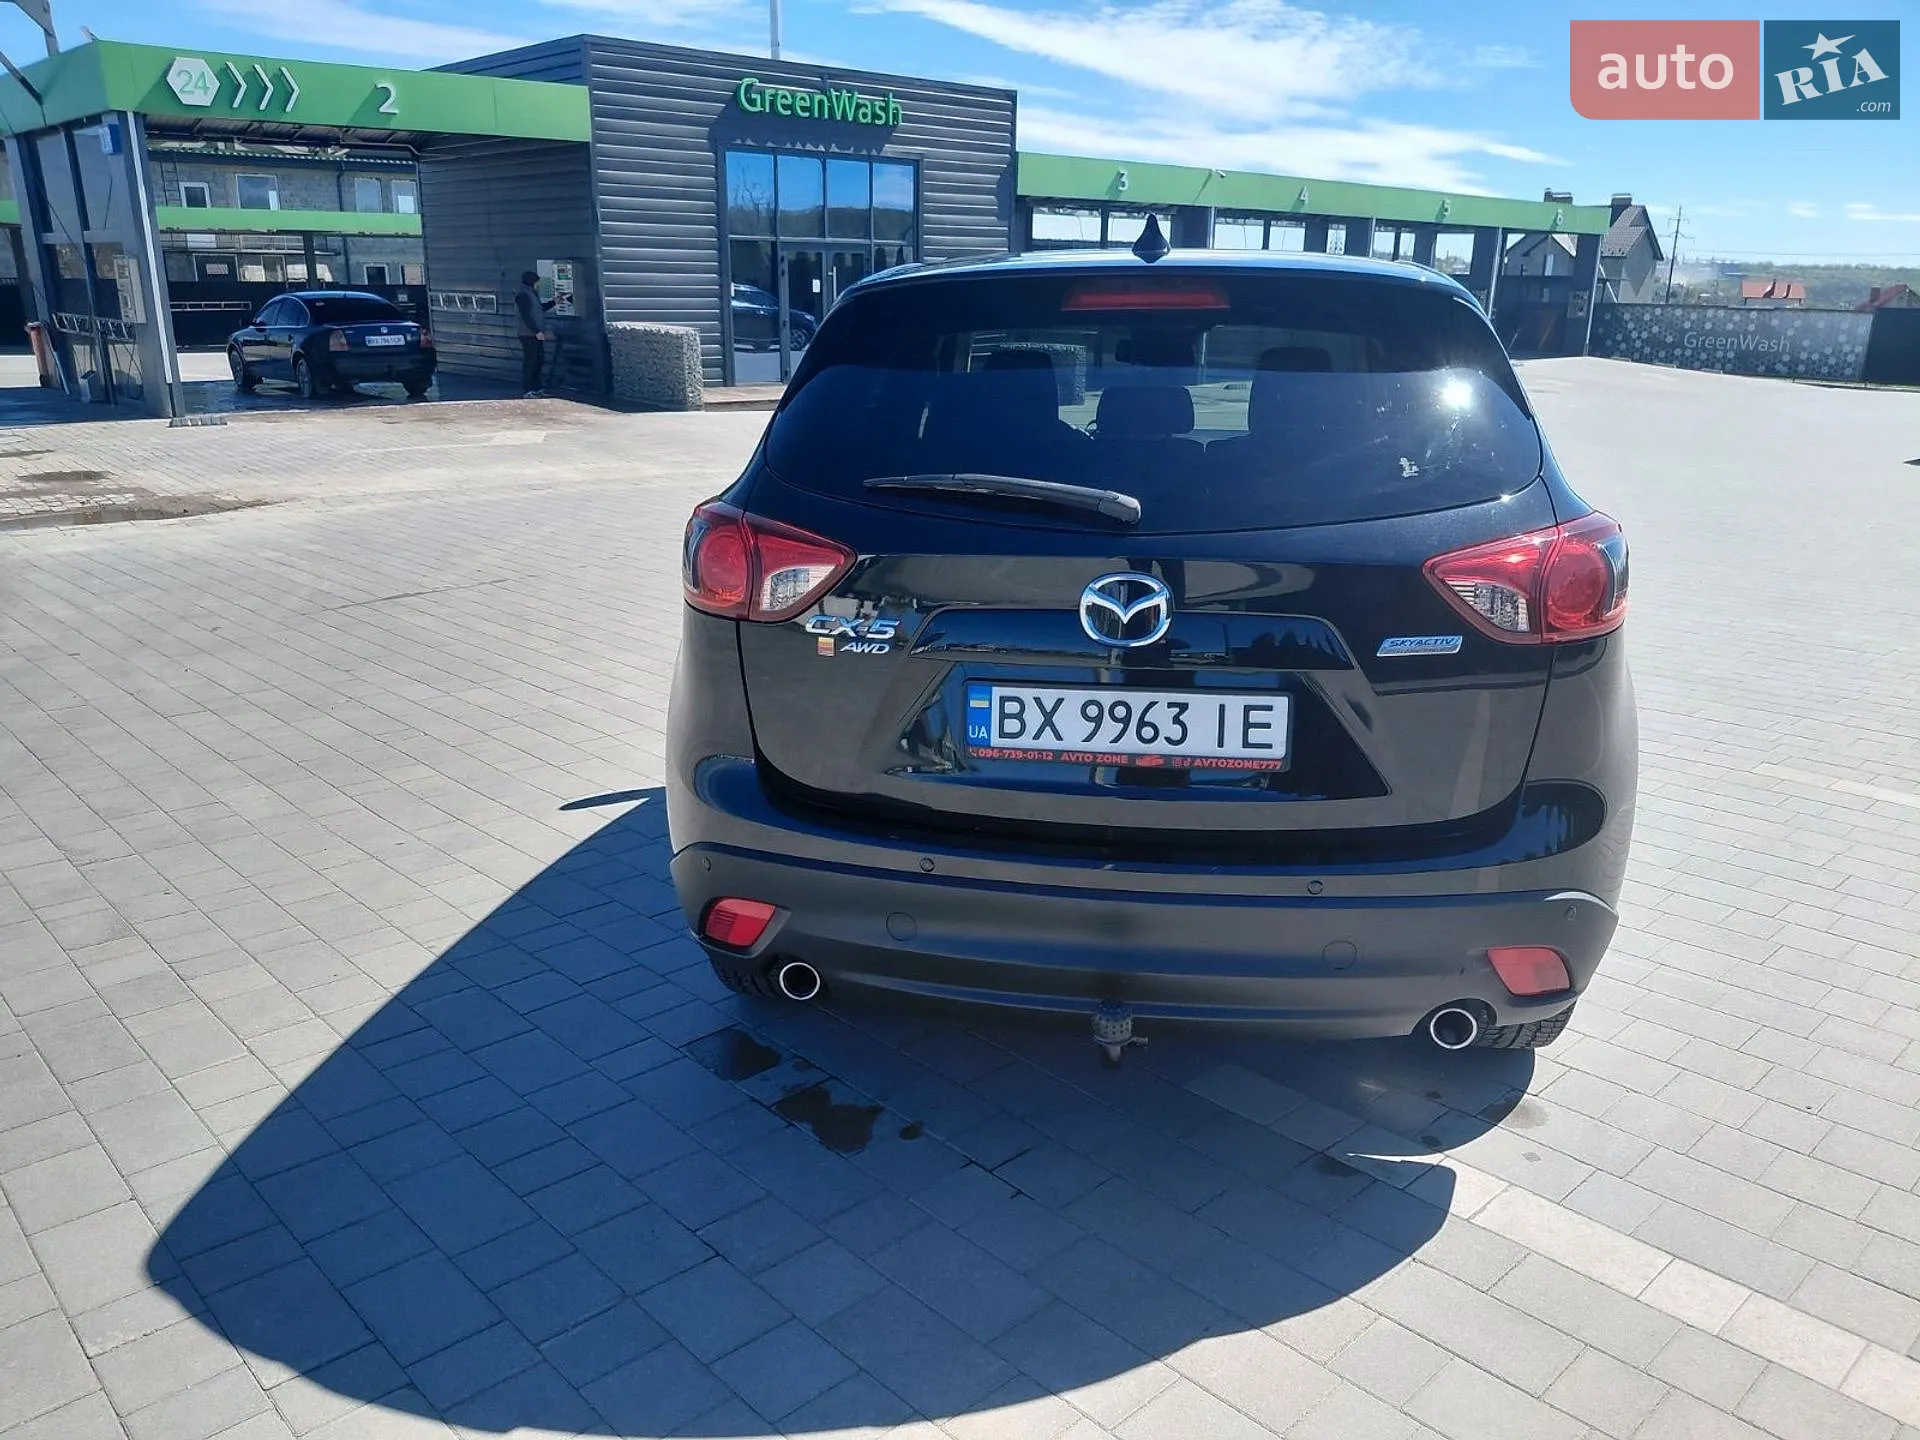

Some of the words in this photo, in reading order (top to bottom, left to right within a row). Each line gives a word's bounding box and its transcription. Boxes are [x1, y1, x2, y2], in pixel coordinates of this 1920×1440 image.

[176, 69, 211, 96] 24
[375, 82, 399, 114] 2
[738, 77, 903, 126] GreenWash
[1118, 169, 1129, 191] 3
[1299, 185, 1309, 204] 4
[1684, 331, 1791, 353] GreenWash
[805, 614, 900, 640] CX-5
[839, 642, 890, 655] AWD
[1388, 637, 1460, 648] SKYACTIV
[968, 725, 988, 740] UA
[998, 695, 1065, 742] BX
[1079, 699, 1190, 747] 9963
[1215, 702, 1275, 750] IE
[1061, 752, 1093, 763] AVTO
[1096, 754, 1129, 765] ZONE
